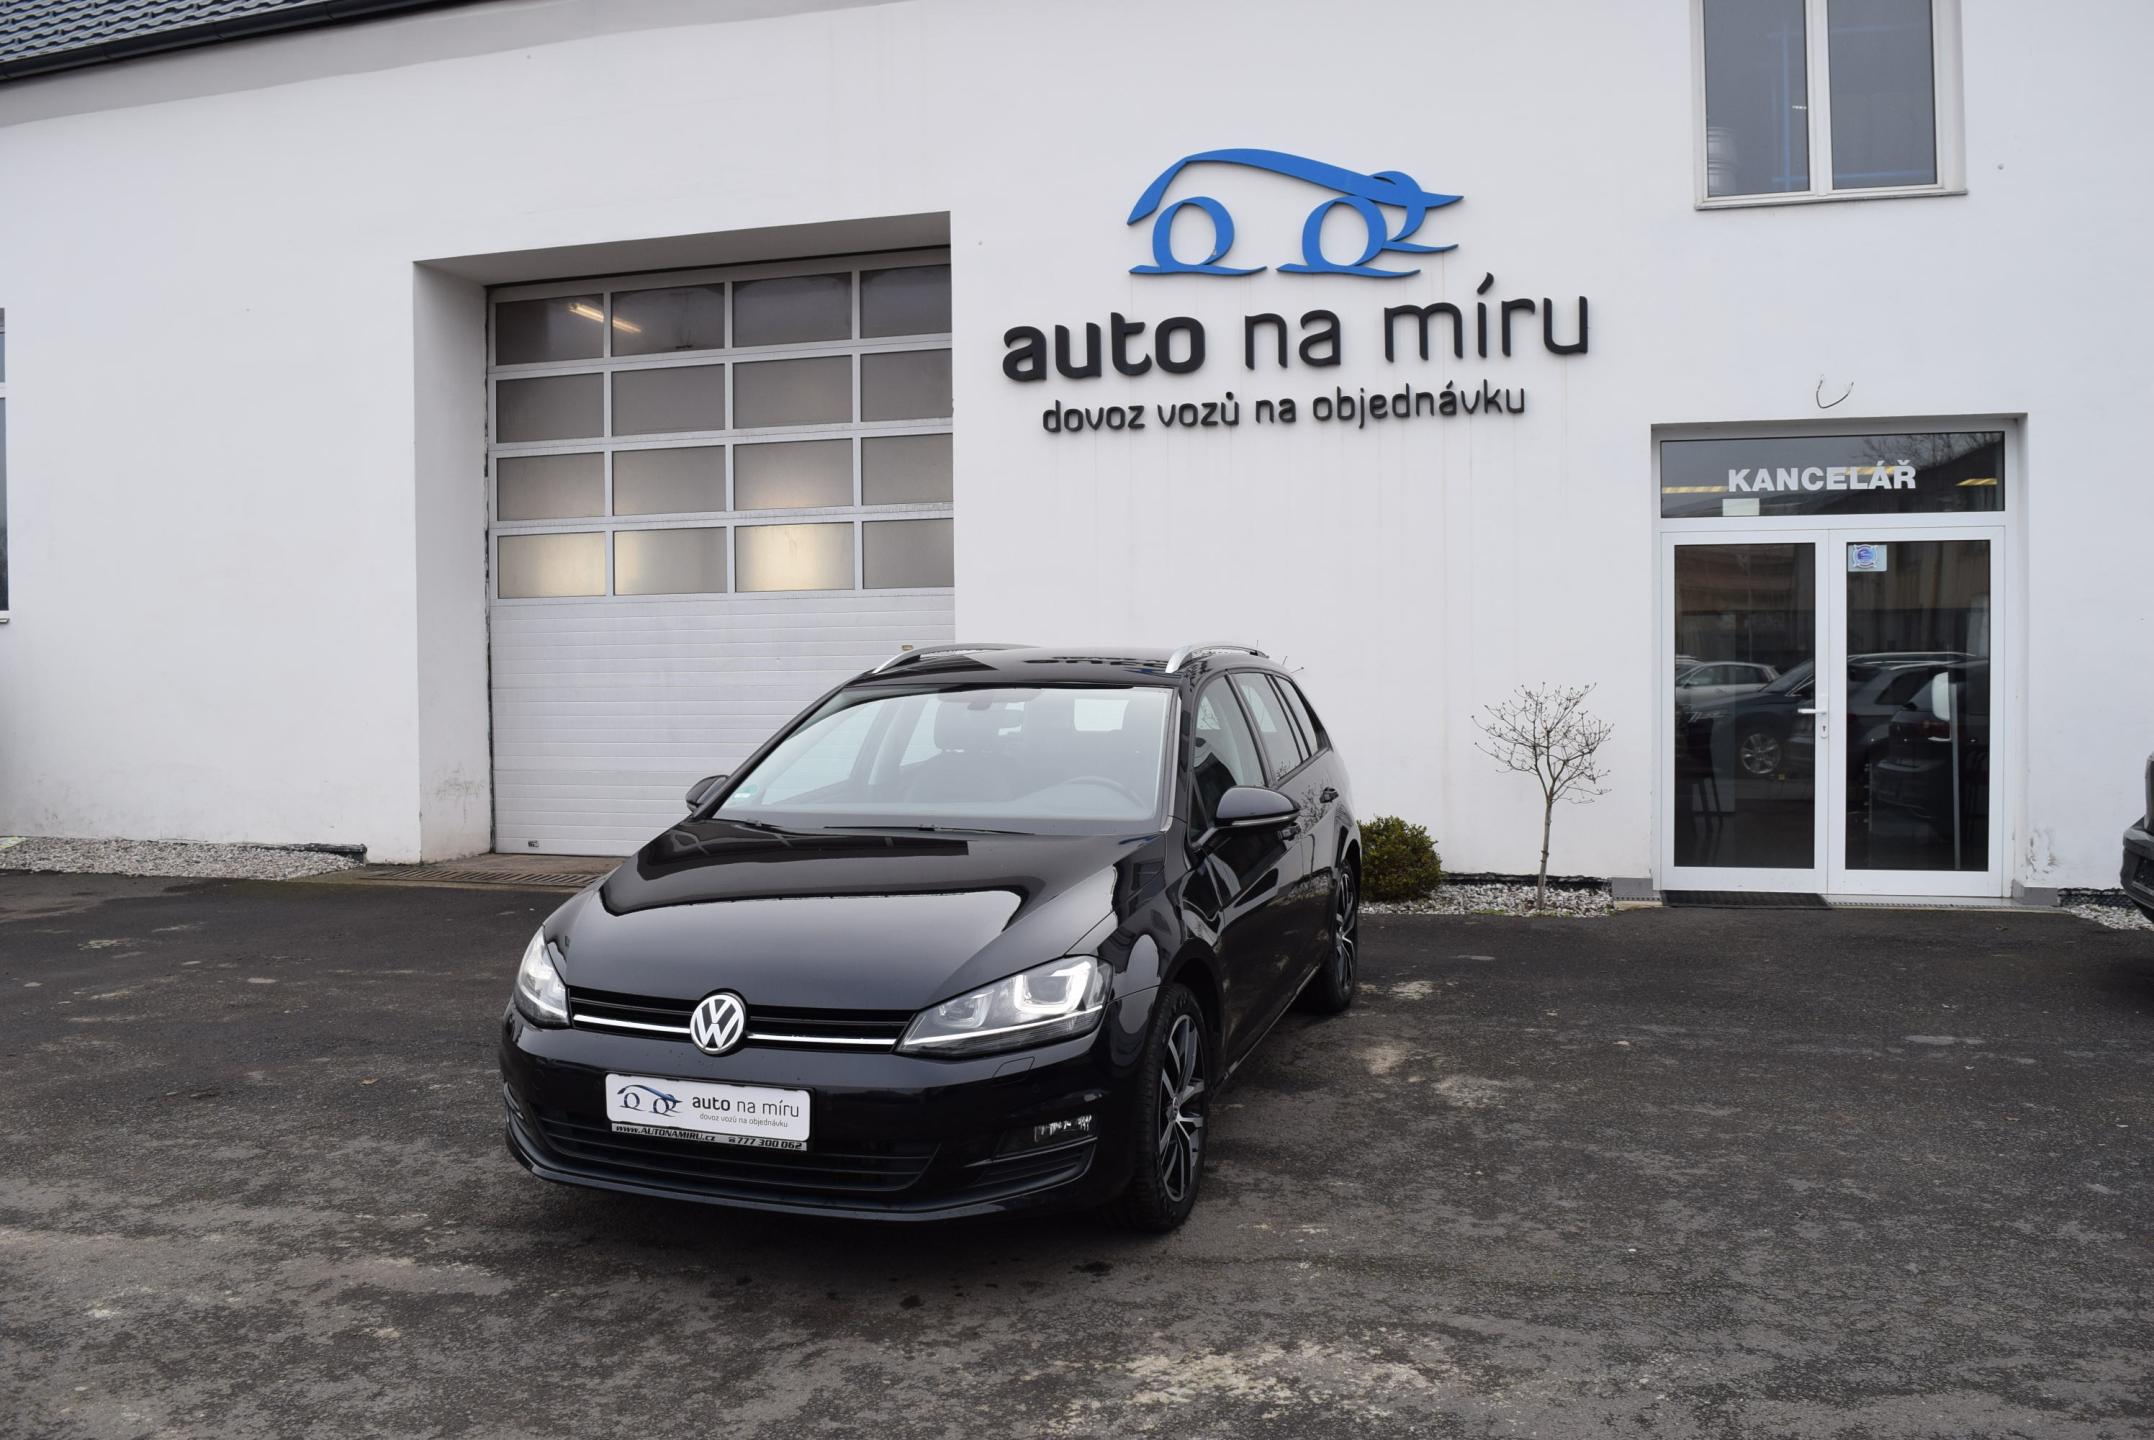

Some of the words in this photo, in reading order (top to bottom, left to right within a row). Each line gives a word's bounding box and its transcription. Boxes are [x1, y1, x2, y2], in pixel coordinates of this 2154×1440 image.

[1001, 311, 1206, 382] auto
[1245, 309, 1341, 370] na
[1384, 272, 1589, 363] míru
[1042, 400, 1145, 433] dovoz
[1157, 391, 1240, 429] vozů
[1255, 397, 1297, 424] na
[1312, 379, 1526, 429] objednávku
[1727, 459, 1916, 493] KANCELÁŘ
[692, 1096, 731, 1112] auto
[737, 1101, 756, 1114] na
[762, 1099, 800, 1119] míru
[699, 1113, 720, 1121] dovoz
[739, 1116, 748, 1124] na
[749, 1117, 789, 1128] objednávku
[738, 1137, 757, 1146] 777
[759, 1139, 779, 1148] 300
